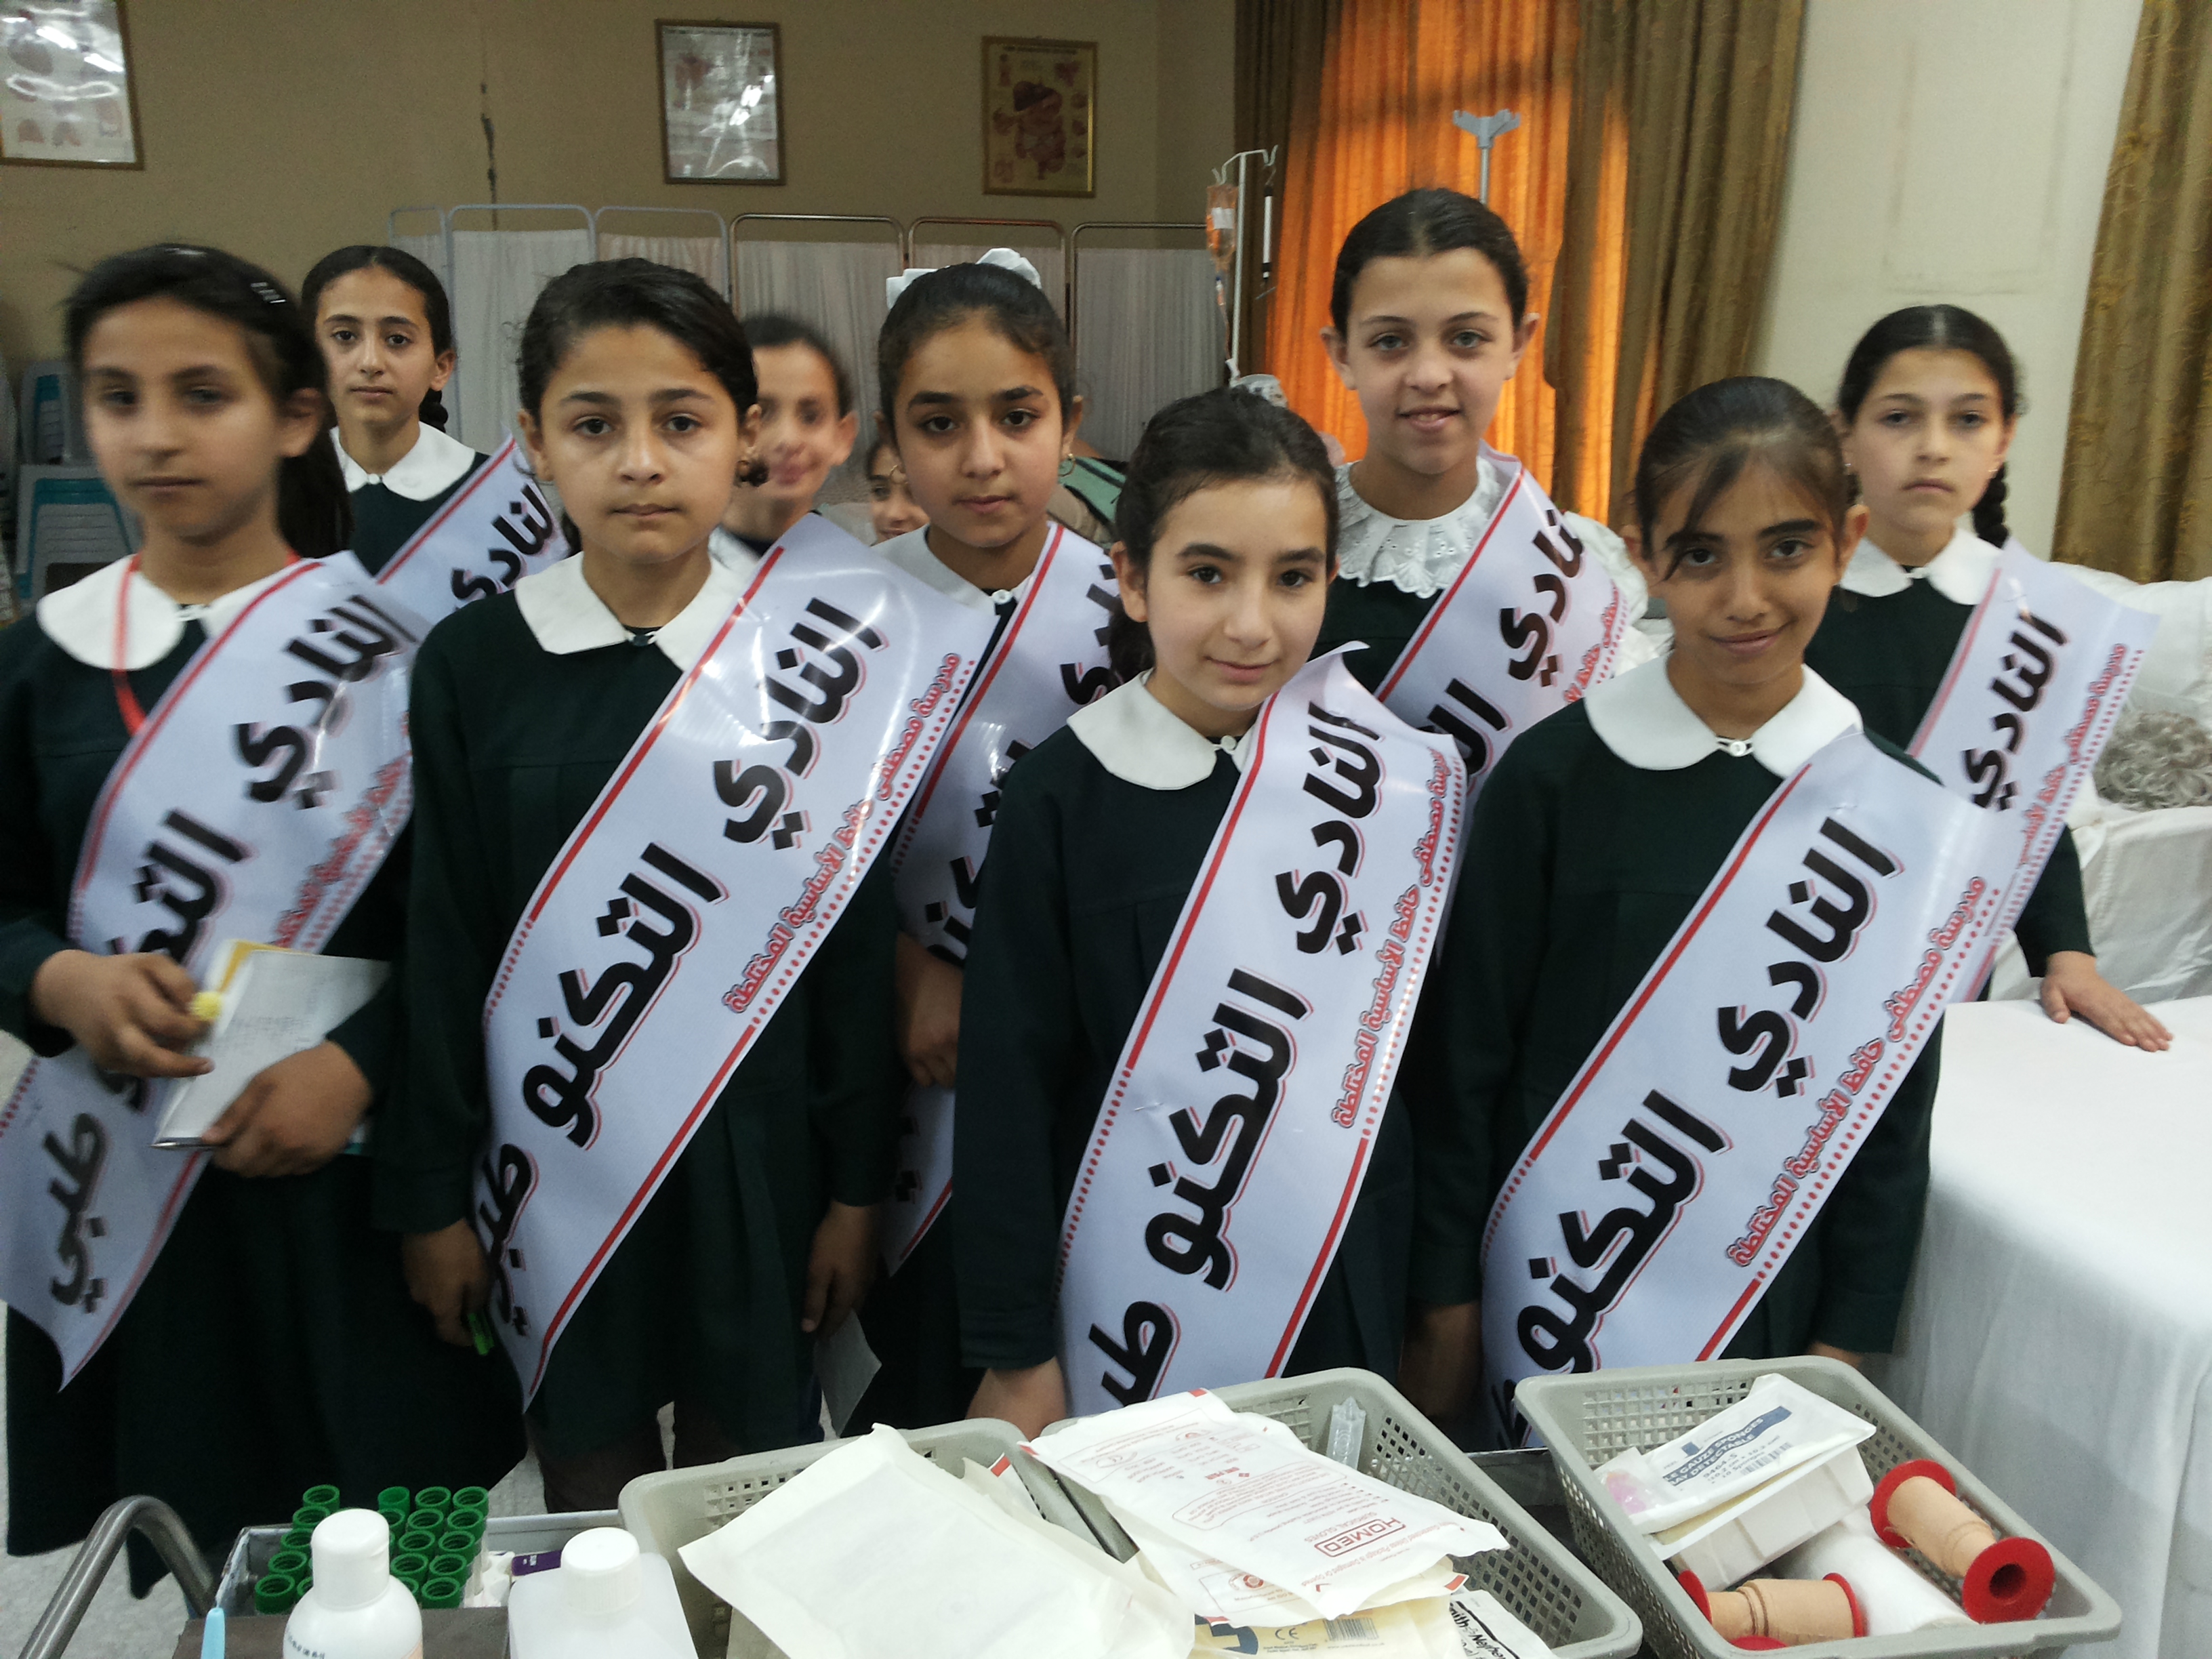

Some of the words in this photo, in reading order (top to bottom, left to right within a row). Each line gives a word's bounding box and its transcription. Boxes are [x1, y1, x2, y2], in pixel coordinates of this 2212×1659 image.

[1500, 509, 1584, 687] نادي
[232, 594, 419, 810] النادي
[714, 596, 889, 851] النادي
[910, 653, 961, 717] مدرسة
[1962, 611, 2068, 811] النادي
[873, 716, 924, 800] مصطفى
[1275, 701, 1385, 956] النادي
[1413, 797, 1445, 887] مصطفى
[1391, 884, 1420, 943] حافظ
[1717, 817, 1904, 1098] النادي
[1928, 876, 1986, 950] مدرسة
[523, 842, 727, 1149] التكنو
[722, 920, 793, 1014] المختلطة
[1361, 939, 1405, 1031] الأساسية
[1884, 948, 1943, 1042] مصطفى
[1330, 1028, 1378, 1129] المختلطة
[1840, 1038, 1885, 1095] حافظ
[1145, 968, 1313, 1291] التكنو
[1784, 1090, 1852, 1179] الأساسية
[1517, 1090, 1732, 1374] التكنو
[1726, 1173, 1798, 1267] المختلطة
[1680, 1448, 1715, 1474] GAUZE
[1715, 1418, 1764, 1448] SPONGES
[1690, 1433, 1755, 1476] DETECTABLE
[1324, 1517, 1401, 1553] HOMED
